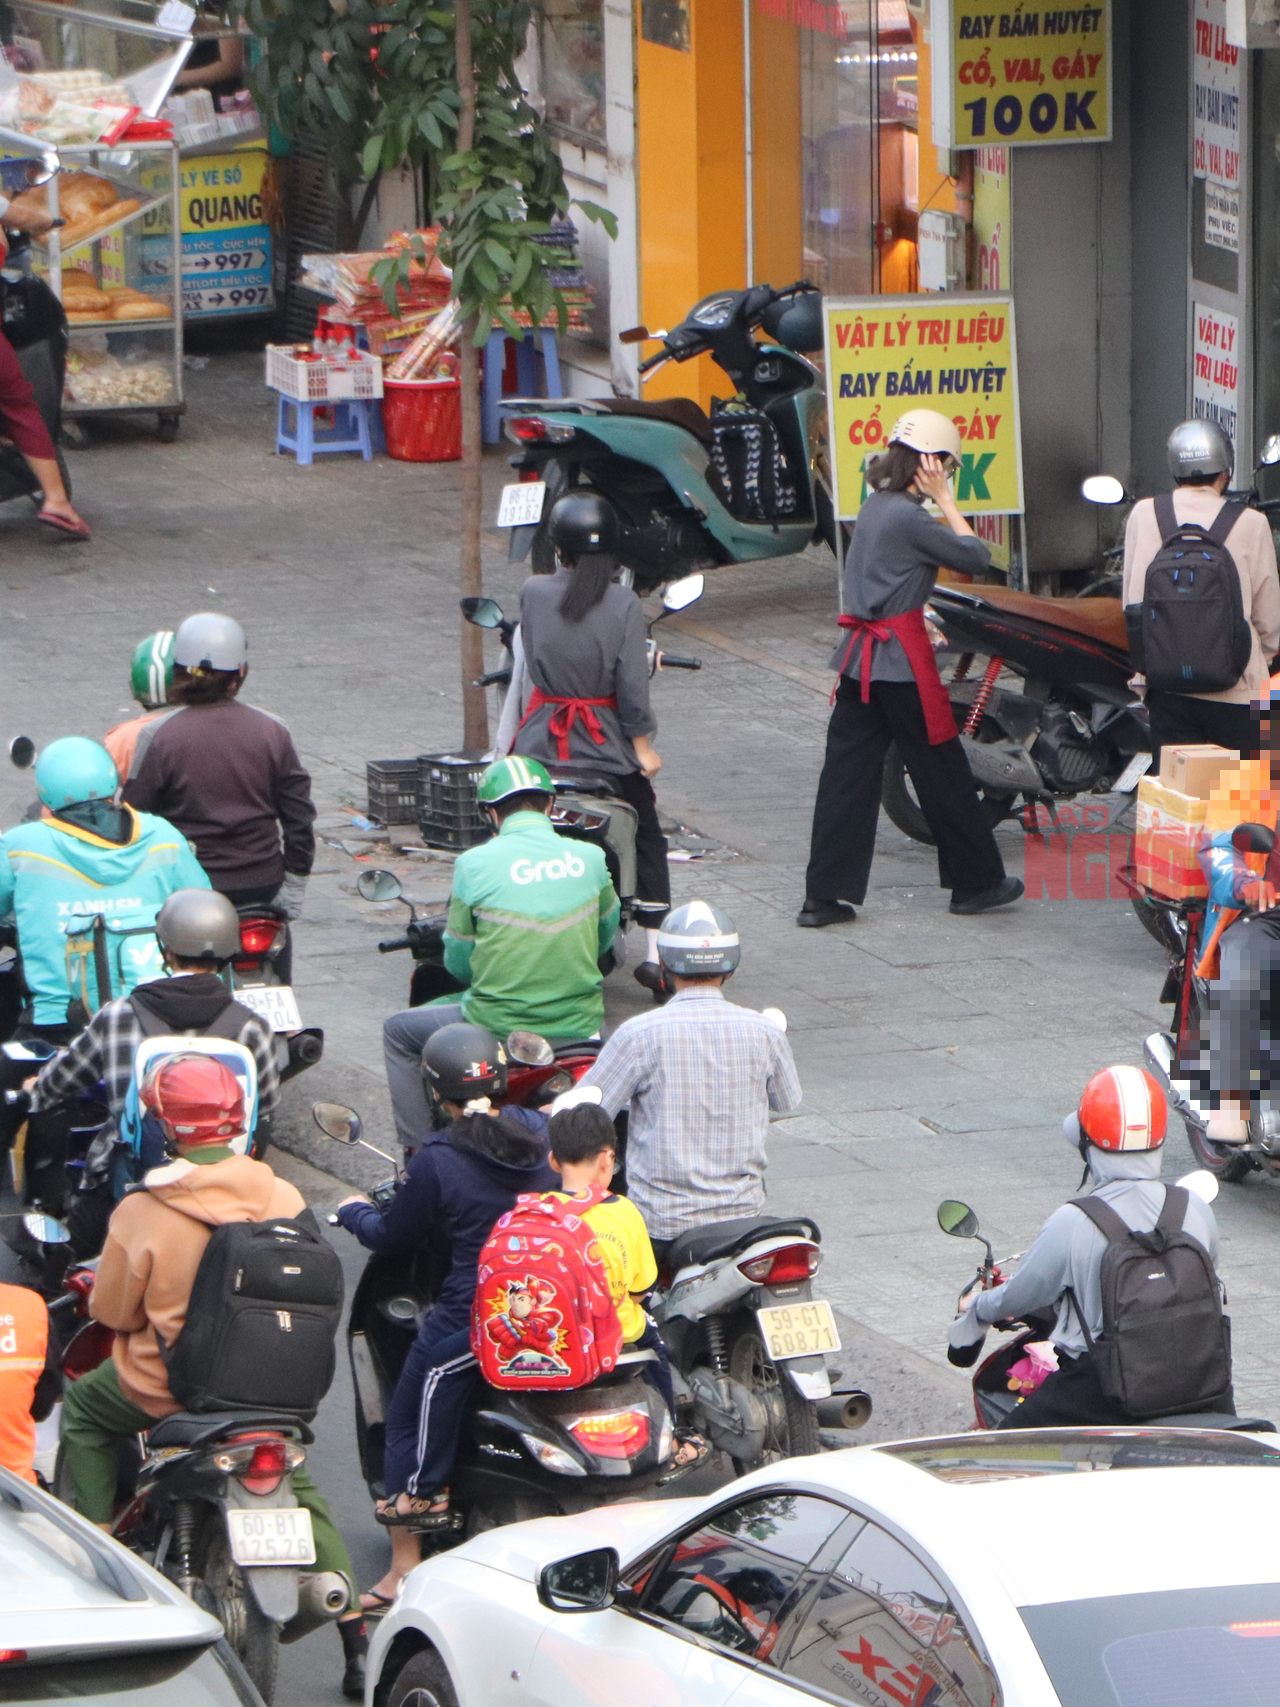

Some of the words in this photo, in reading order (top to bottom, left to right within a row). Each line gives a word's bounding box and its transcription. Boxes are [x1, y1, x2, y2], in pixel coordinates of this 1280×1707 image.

[959, 15, 995, 39] RAY
[998, 2, 1039, 38] BẤM
[1043, 3, 1101, 40] HUYỆT
[1196, 18, 1213, 69] TRỊ
[958, 46, 996, 88] CỔ,
[1003, 58, 1045, 86] VAI,
[1052, 48, 1103, 81] GÁY
[963, 90, 1098, 137] 100K
[181, 168, 198, 188] LÝ
[224, 163, 242, 185] SỐ
[189, 194, 263, 228] QUANG
[215, 252, 253, 270] 997
[229, 287, 269, 306] 997
[836, 316, 879, 356] VẬT
[883, 313, 912, 347] LÝ
[917, 319, 951, 352] TRỊ
[956, 311, 1005, 351] LIỆU
[1199, 314, 1220, 351] VẬT
[1221, 321, 1236, 352] LÝ
[839, 372, 881, 398] RAY
[886, 357, 932, 396] BẤM
[938, 361, 1007, 401] HUYỆT
[1195, 352, 1212, 388] TRỊ
[1213, 357, 1238, 395] LIỆU
[510, 851, 585, 885] Grab
[57, 900, 113, 916] XANH
[776, 1287, 799, 1295] HONDA
[770, 1306, 821, 1331] 59-G1
[770, 1328, 833, 1356] 608.71
[242, 1514, 297, 1536] 60-B1
[239, 1538, 312, 1561] 125.26
